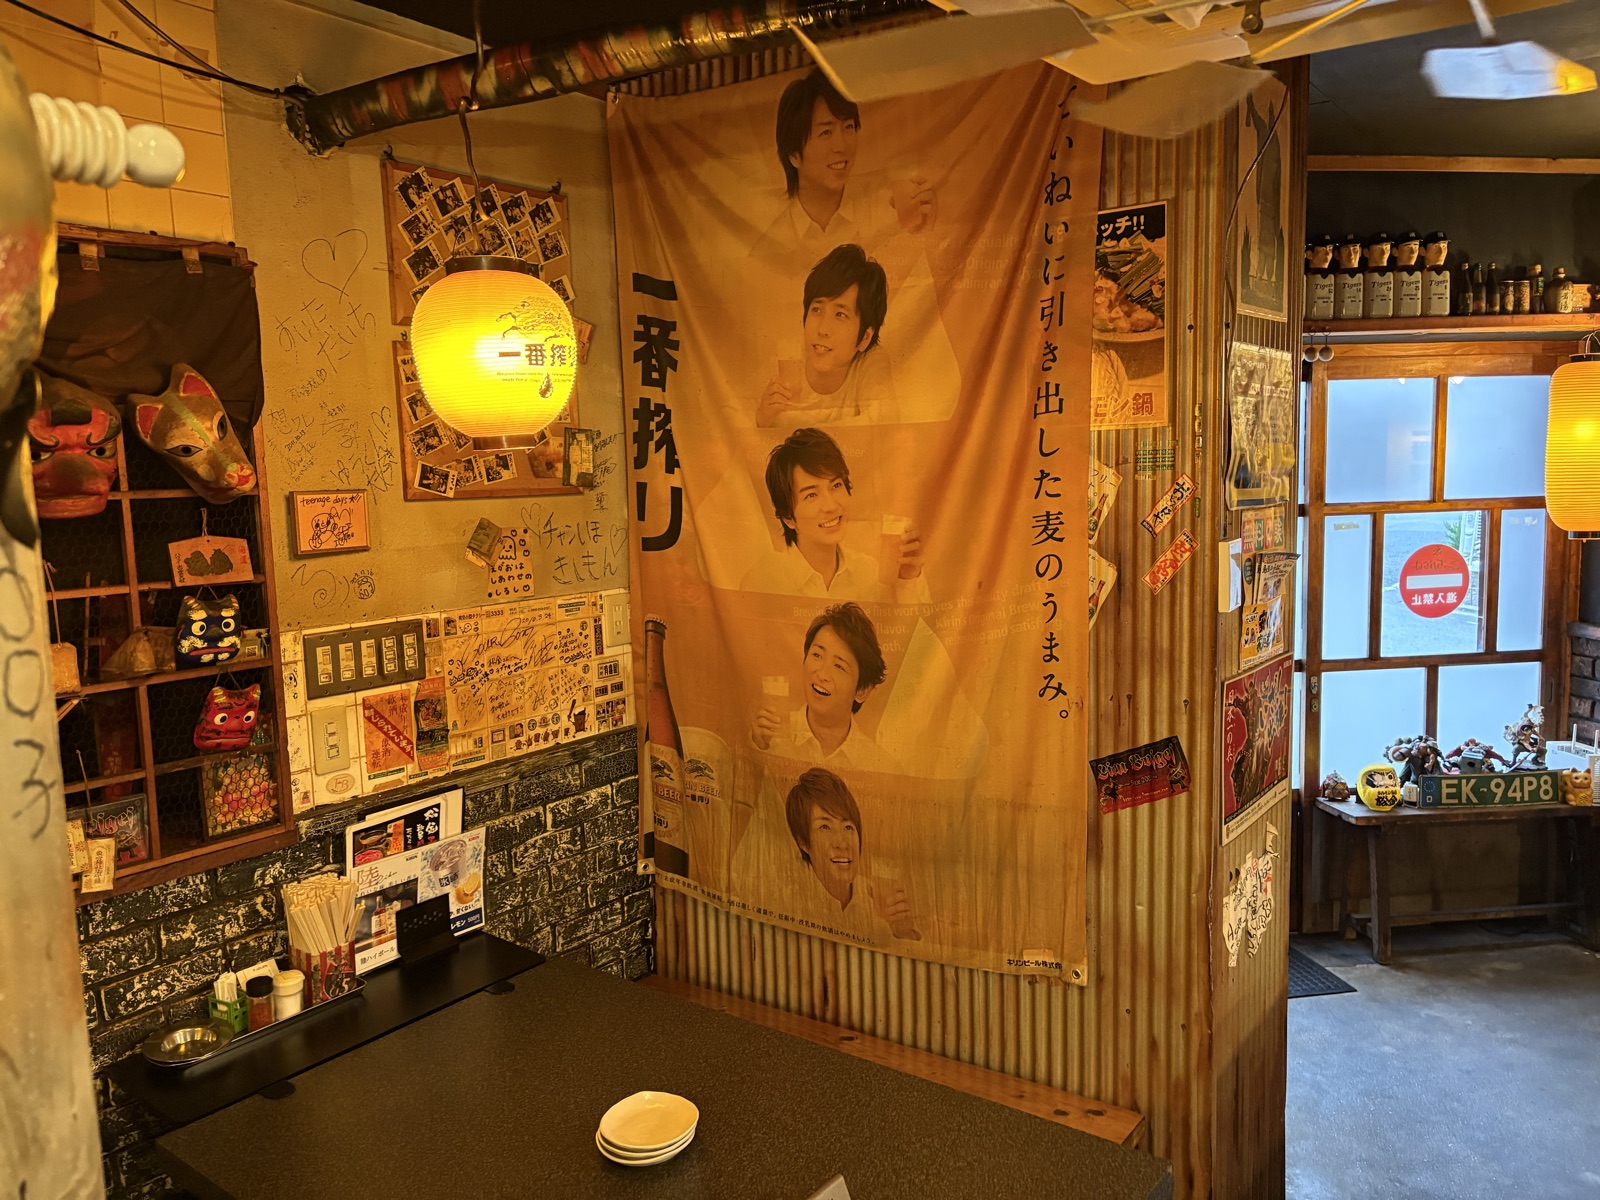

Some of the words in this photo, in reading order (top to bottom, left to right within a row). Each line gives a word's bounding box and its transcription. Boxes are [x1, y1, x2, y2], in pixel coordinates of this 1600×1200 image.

[1096, 214, 1145, 237] ッチ!!
[1314, 283, 1333, 292] Tigers
[1341, 282, 1362, 291] Tigers
[1371, 281, 1392, 290] Tigers
[1400, 280, 1420, 289] Tigers
[1428, 279, 1448, 288] Tigers
[632, 272, 683, 552] 一番搾り
[1440, 775, 1554, 805] EK-94P8
